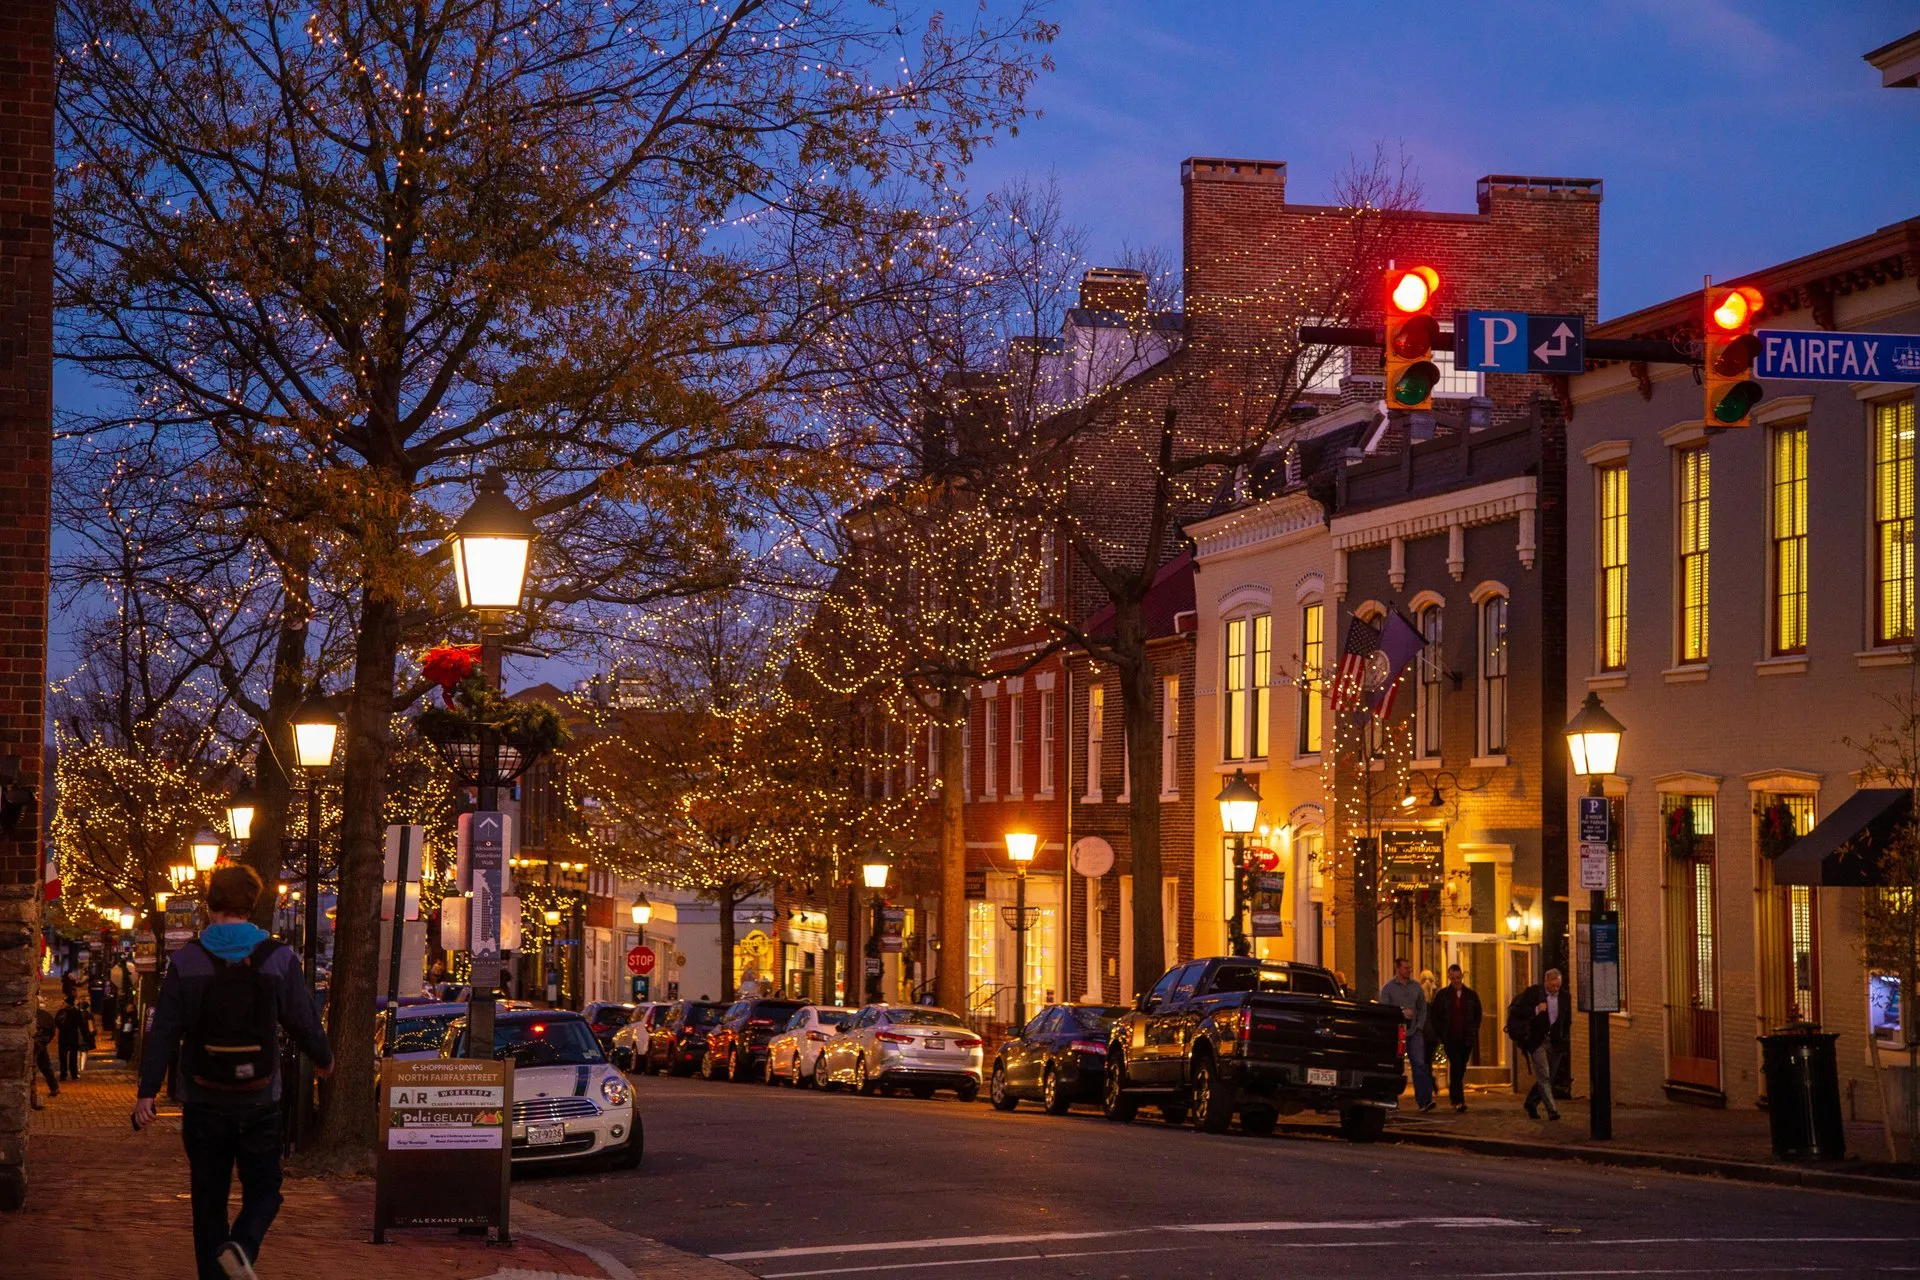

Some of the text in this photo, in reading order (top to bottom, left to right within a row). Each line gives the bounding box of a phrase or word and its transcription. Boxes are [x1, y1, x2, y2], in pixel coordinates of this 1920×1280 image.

[1479, 317, 1517, 367] P
[1766, 337, 1880, 376] FAIRFAX
[1590, 800, 1599, 813] P
[629, 955, 653, 966] STOP
[638, 980, 645, 990] P
[439, 1090, 492, 1098] WORKSHOP
[402, 1109, 474, 1122] Dolci GELATI
